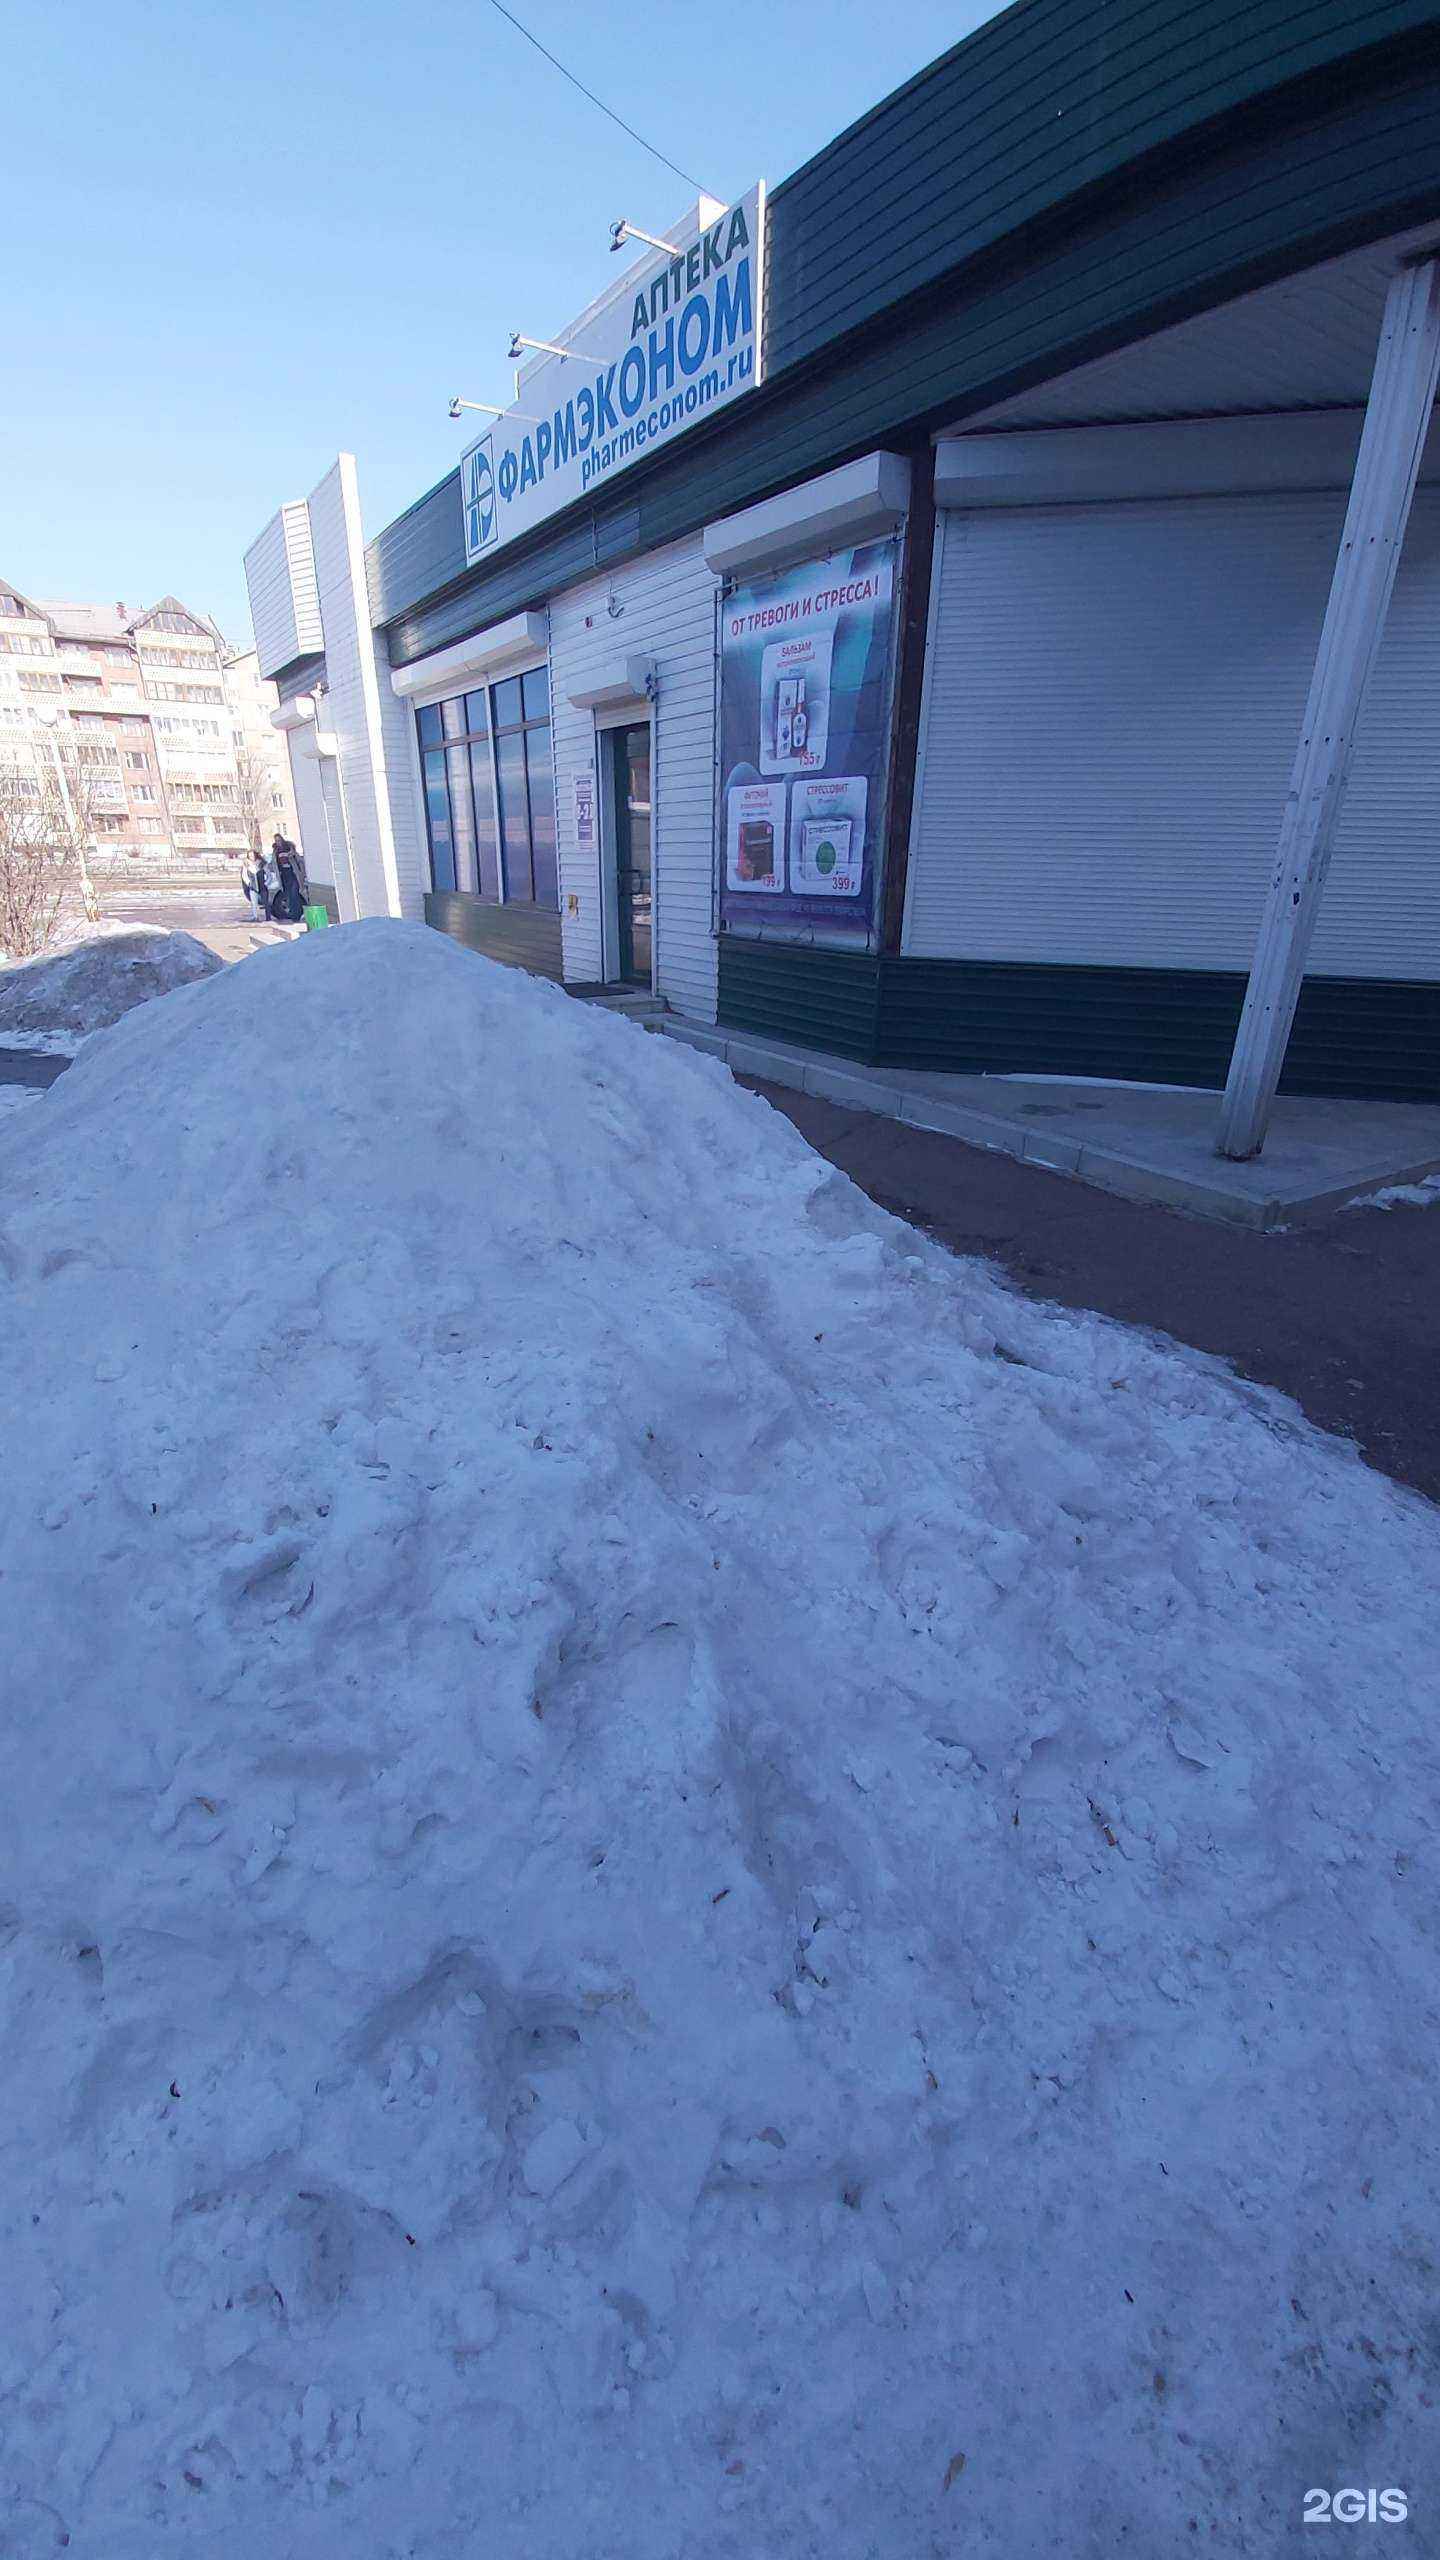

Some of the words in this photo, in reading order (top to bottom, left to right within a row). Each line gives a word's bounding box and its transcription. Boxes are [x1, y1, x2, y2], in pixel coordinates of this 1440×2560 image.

[631, 206, 750, 340] АПТЕКА
[498, 257, 752, 503] ФАРМЭКОНОМ
[581, 344, 752, 490] pharmeconom.ru
[731, 618, 746, 636] ОТ
[748, 602, 799, 632] ТРЕВОГИ
[802, 597, 812, 616] И
[832, 877, 850, 890] 399
